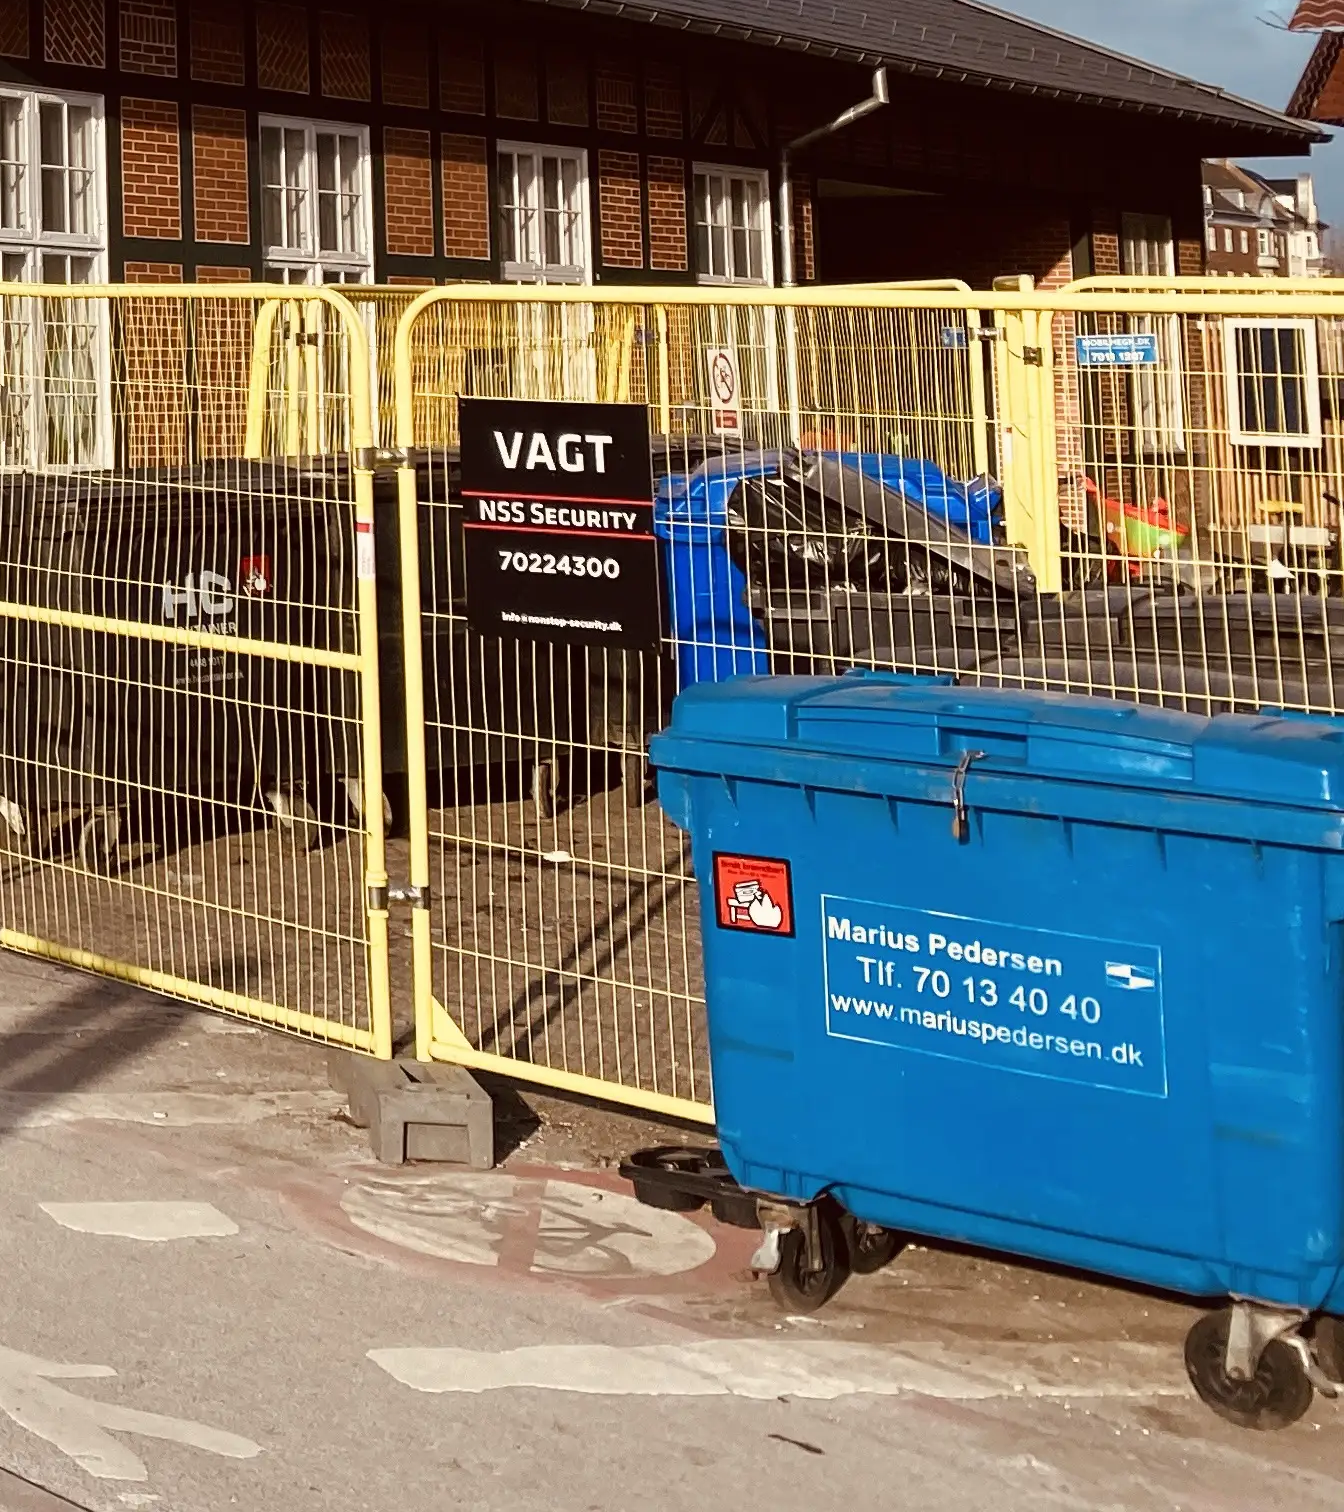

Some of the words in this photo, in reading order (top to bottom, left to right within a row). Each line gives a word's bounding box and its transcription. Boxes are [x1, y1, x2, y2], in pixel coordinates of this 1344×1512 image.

[493, 430, 613, 473] VAGT
[478, 499, 525, 523] NSS
[498, 550, 620, 579] 70224300
[163, 570, 234, 619] HC
[827, 916, 920, 953] Marius
[928, 932, 1062, 976] Pedersen
[856, 955, 902, 988] Tlf.
[912, 966, 951, 998] 70
[962, 976, 999, 1007] 13
[1009, 985, 1049, 1016] 40
[1059, 994, 1102, 1024] 40
[830, 993, 1145, 1068] www.mariuspedersen.dk
